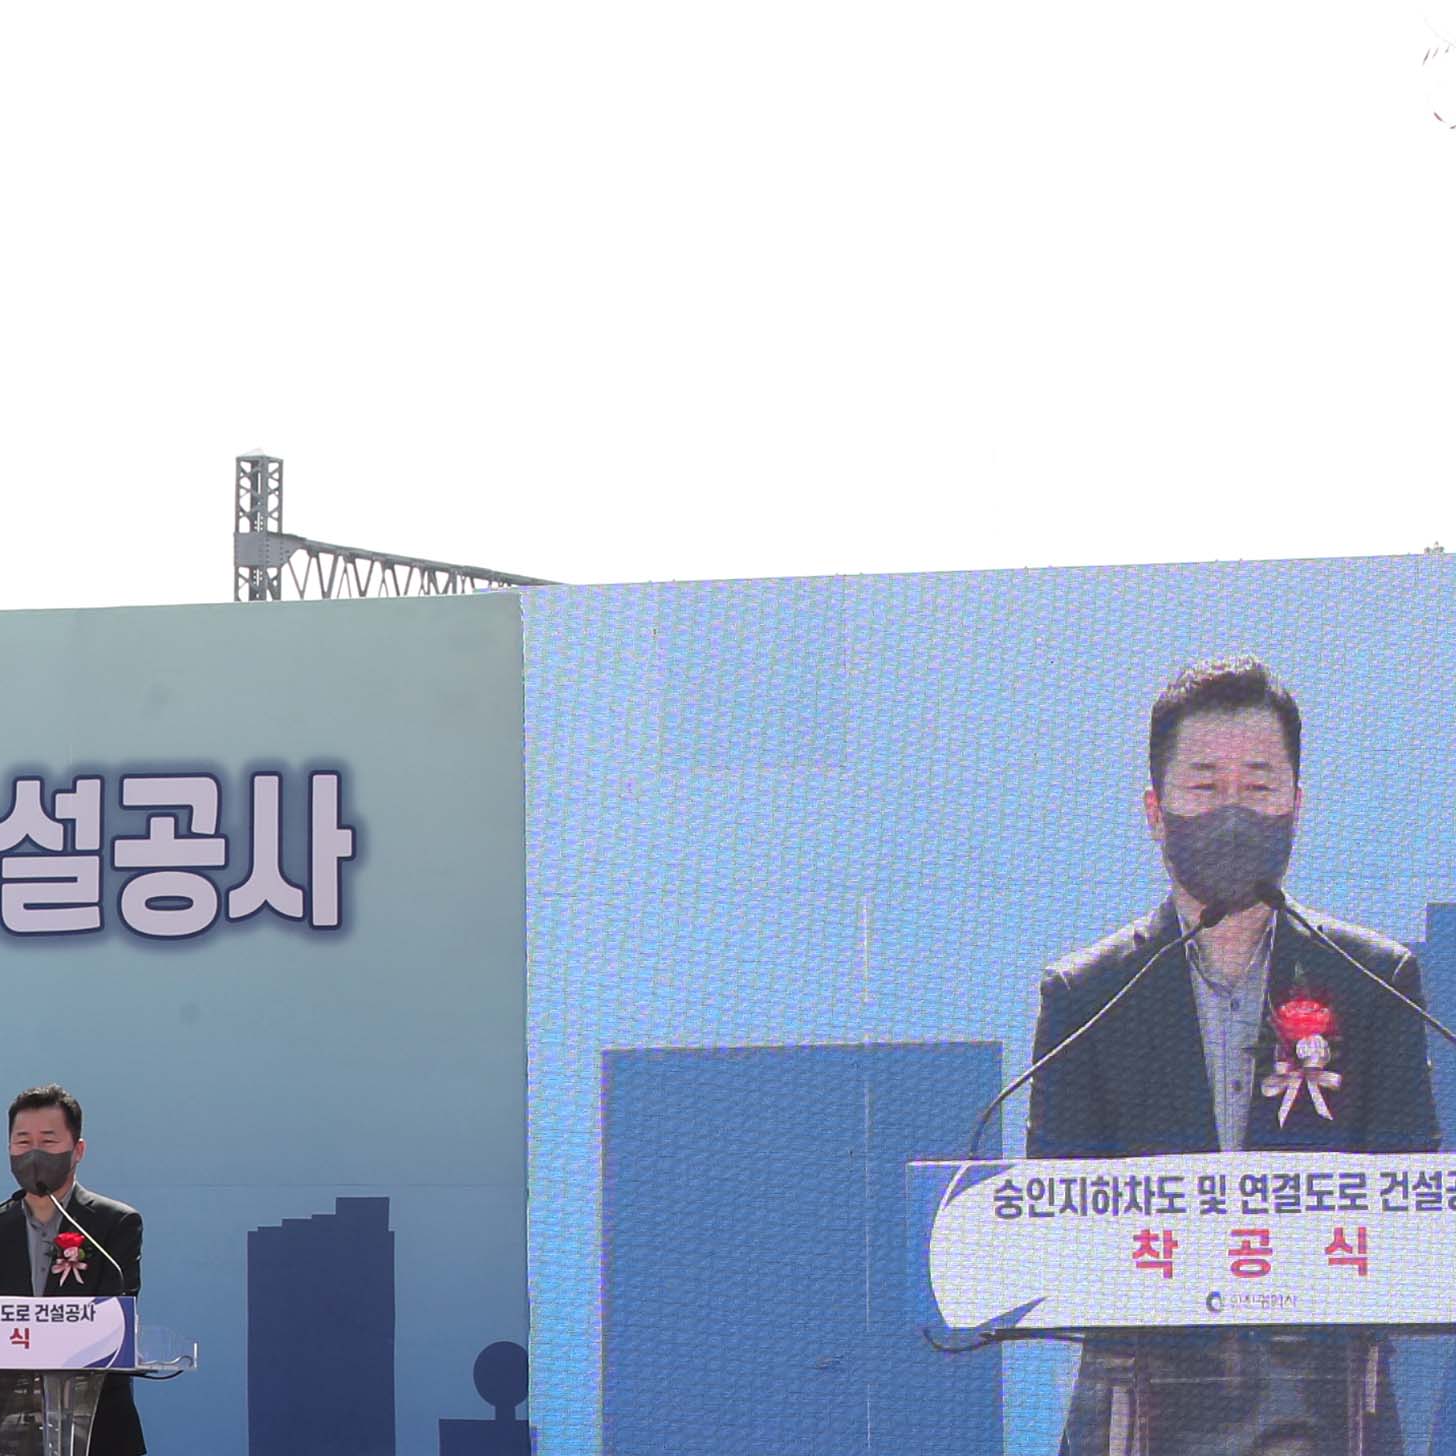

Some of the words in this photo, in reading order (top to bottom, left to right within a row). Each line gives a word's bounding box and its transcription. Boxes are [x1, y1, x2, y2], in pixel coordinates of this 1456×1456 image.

[993, 1174, 1186, 1220] 숭인지하차도
[1197, 1173, 1228, 1215] 및
[1238, 1171, 1368, 1215] 연결도로
[34, 1304, 96, 1322] 건설공사
